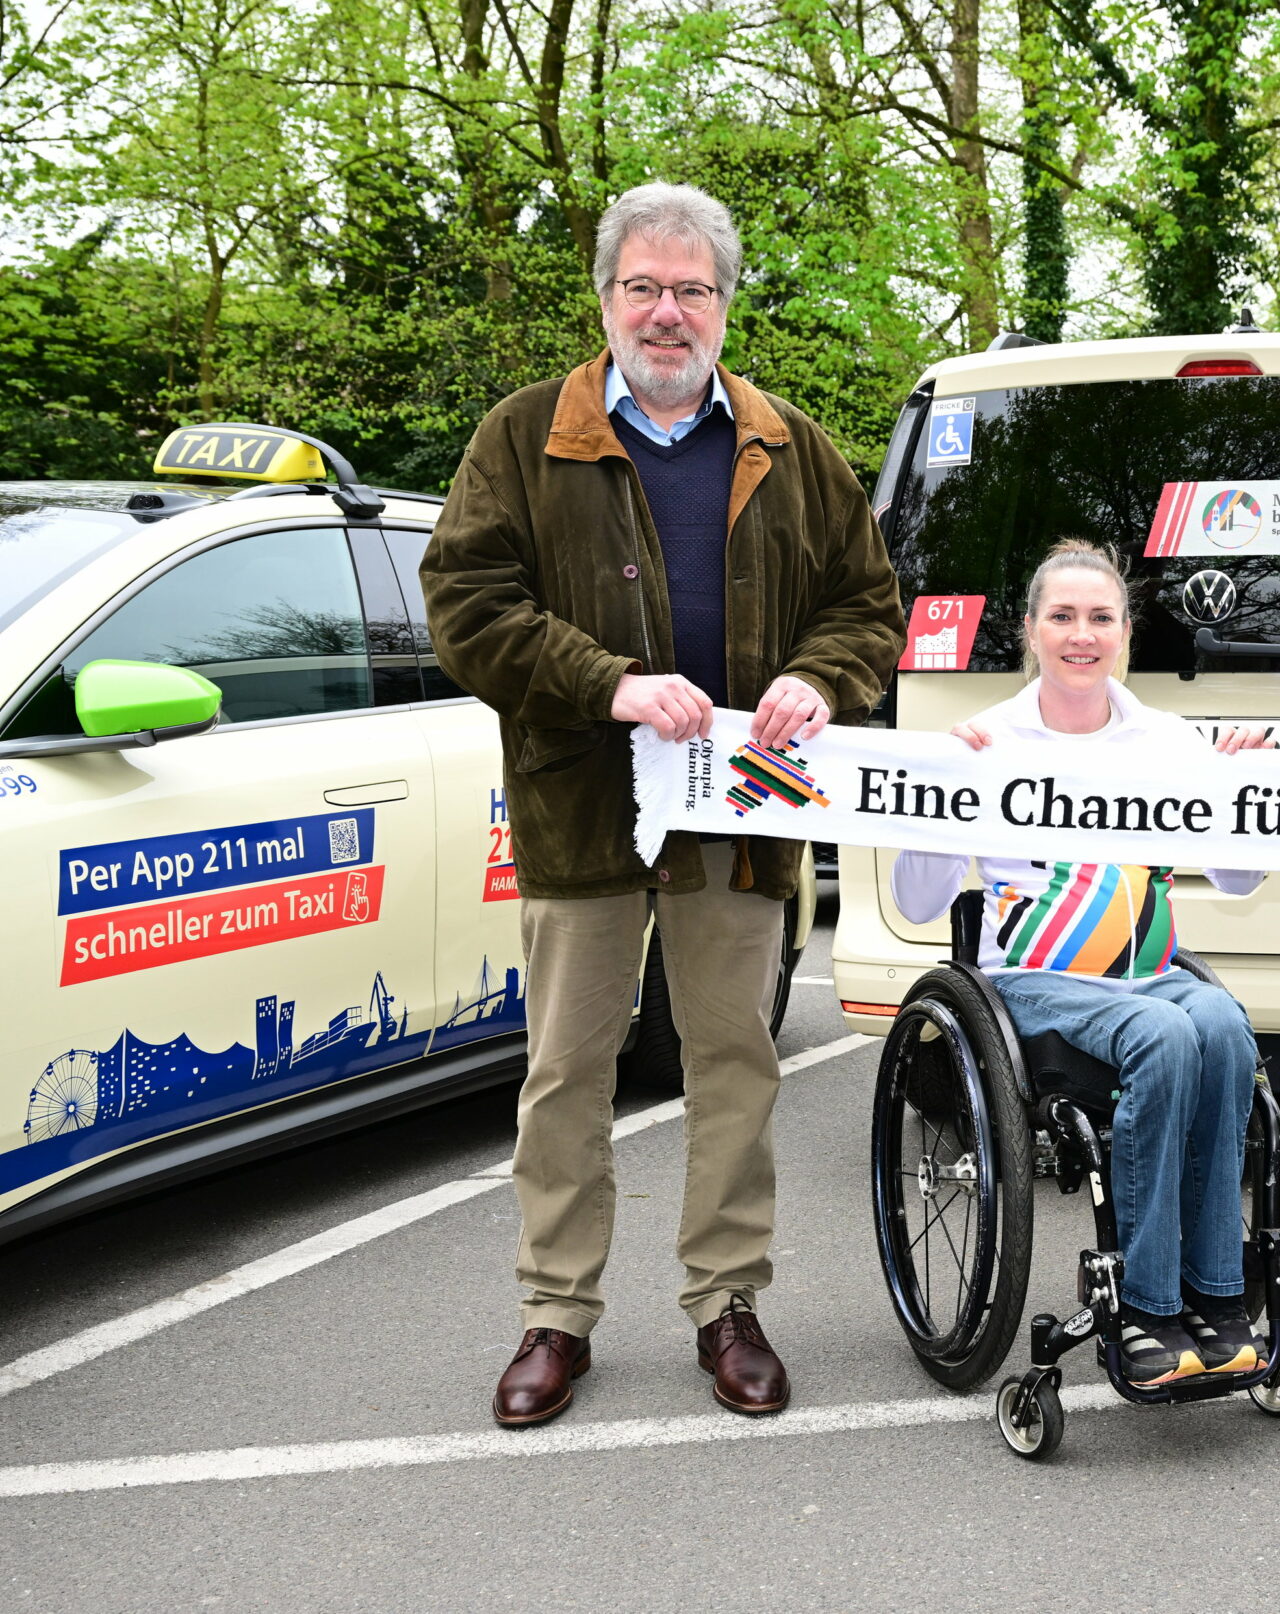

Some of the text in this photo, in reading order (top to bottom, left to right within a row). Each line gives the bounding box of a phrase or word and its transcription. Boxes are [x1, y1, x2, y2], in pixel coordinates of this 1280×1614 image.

[935, 402, 961, 410] FRICKE
[175, 434, 271, 469] TAXI
[928, 600, 964, 620] 671
[685, 741, 699, 812] Hamburg.
[700, 738, 714, 798] Olympia
[490, 787, 509, 824] H
[855, 766, 980, 823] Eine
[999, 778, 1213, 832] Chance
[68, 826, 305, 895] Per App 211 mal
[74, 883, 335, 964] schneller zum Taxi
